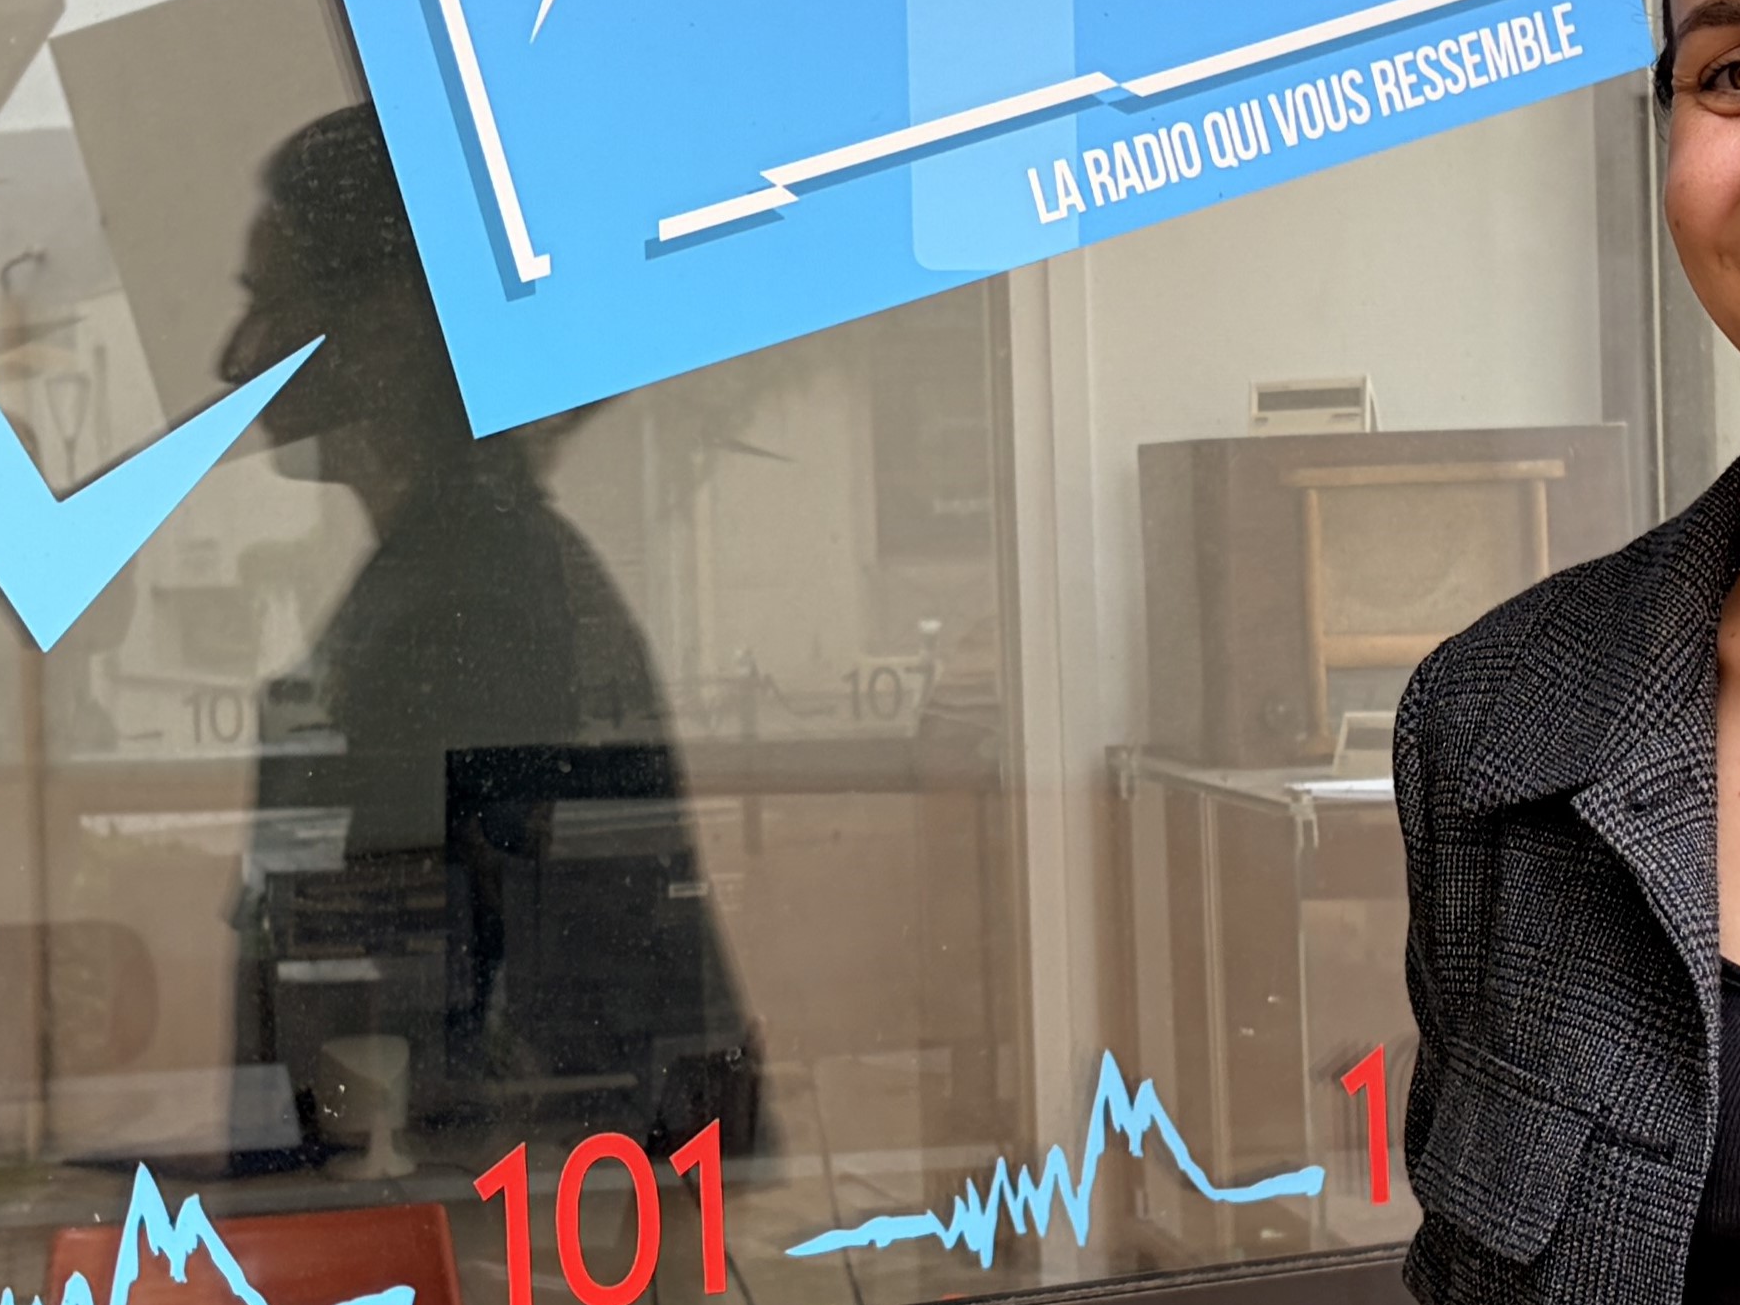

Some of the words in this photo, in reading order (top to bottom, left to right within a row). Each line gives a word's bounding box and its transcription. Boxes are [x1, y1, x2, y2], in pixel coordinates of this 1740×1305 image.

[1027, 156, 1086, 225] LA
[1083, 119, 1202, 207] RADIO
[1201, 91, 1272, 170] QUI
[1267, 67, 1372, 148] VOUS
[1369, 0, 1584, 118] RESSEMBLE
